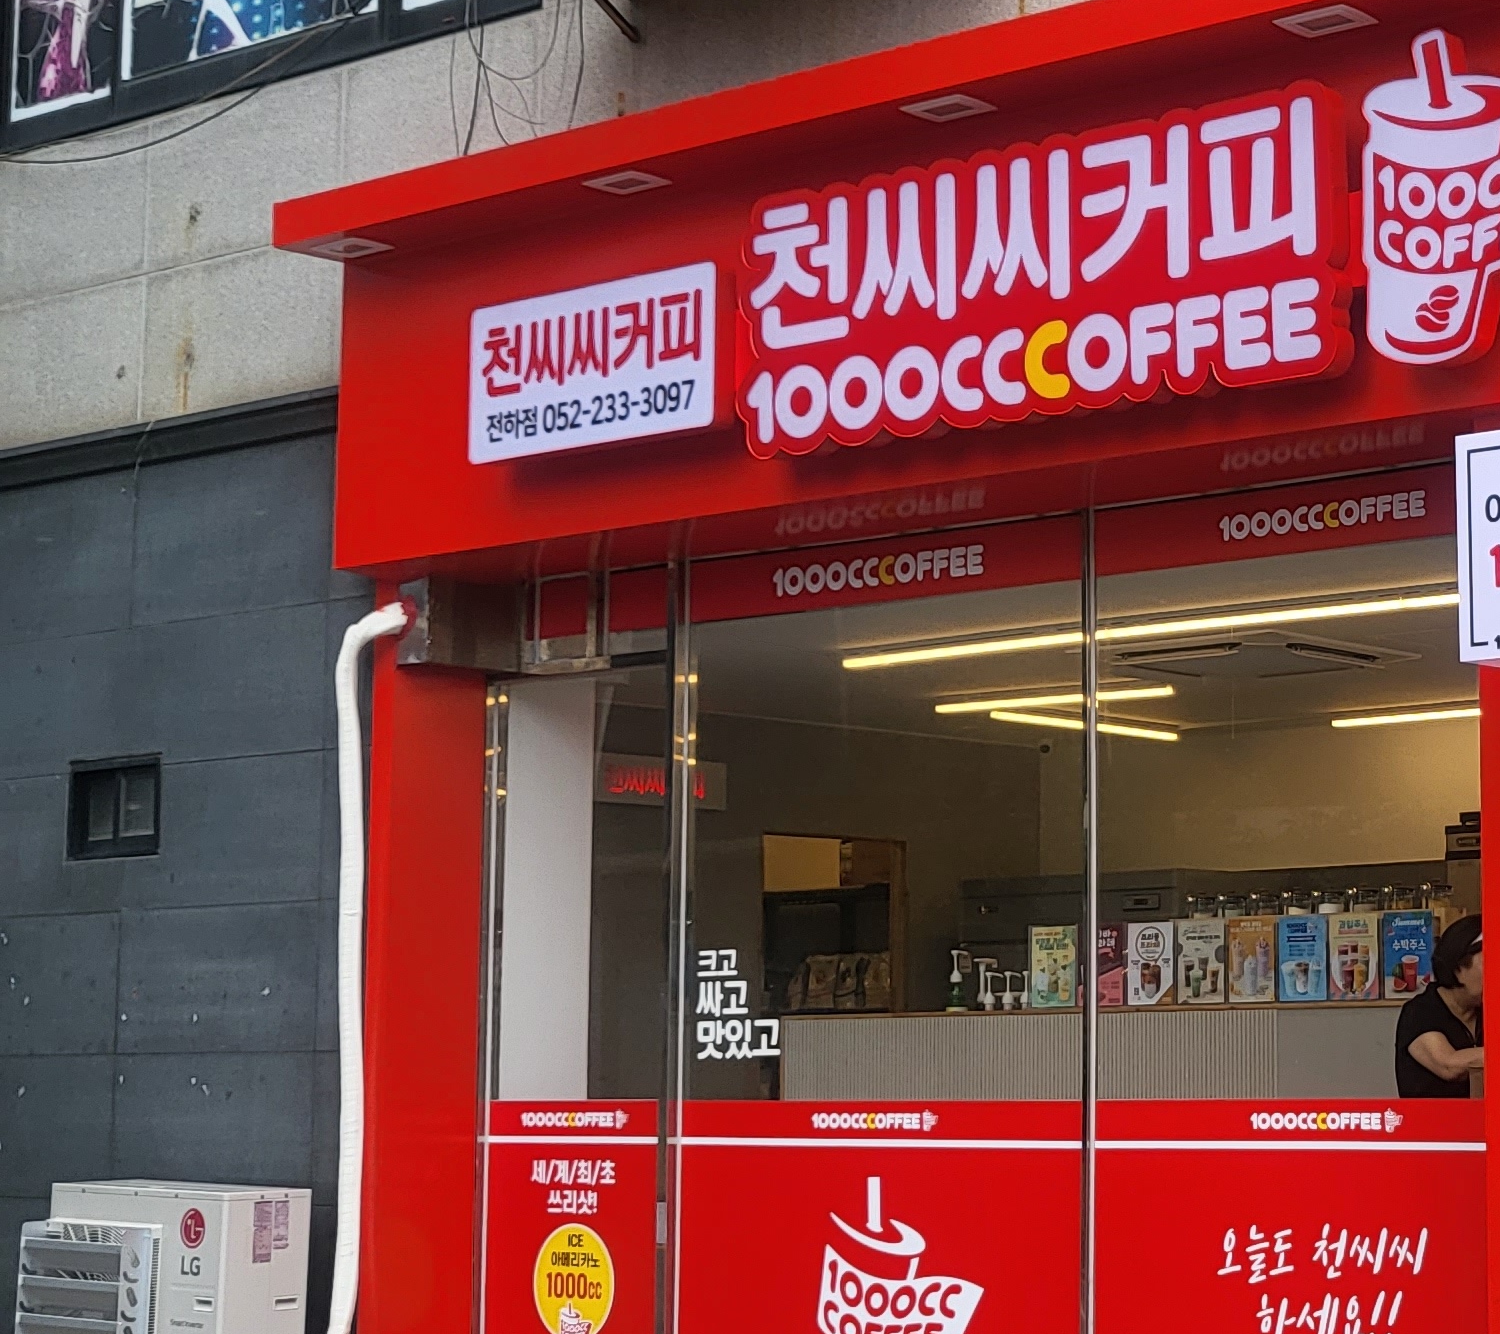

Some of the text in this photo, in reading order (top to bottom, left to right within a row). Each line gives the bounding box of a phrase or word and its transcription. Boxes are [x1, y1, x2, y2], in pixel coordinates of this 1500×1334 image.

[750, 95, 1318, 350] 천씨씨커피
[482, 288, 703, 398] 천씨씨커피
[486, 379, 696, 444] 전하점 052-233-3097
[697, 948, 739, 978] 크고
[696, 981, 749, 1017] 싸고
[696, 1019, 781, 1060] 맛있고
[530, 1159, 616, 1187] 세/계/최/초
[567, 1233, 584, 1249] ICE
[1216, 1222, 1429, 1285] 오늘도 천씨씨
[181, 1256, 201, 1276] LG
[551, 1251, 601, 1268] 아메리카노
[546, 1271, 603, 1300] 1000cc
[828, 1260, 962, 1320] 1000CC
